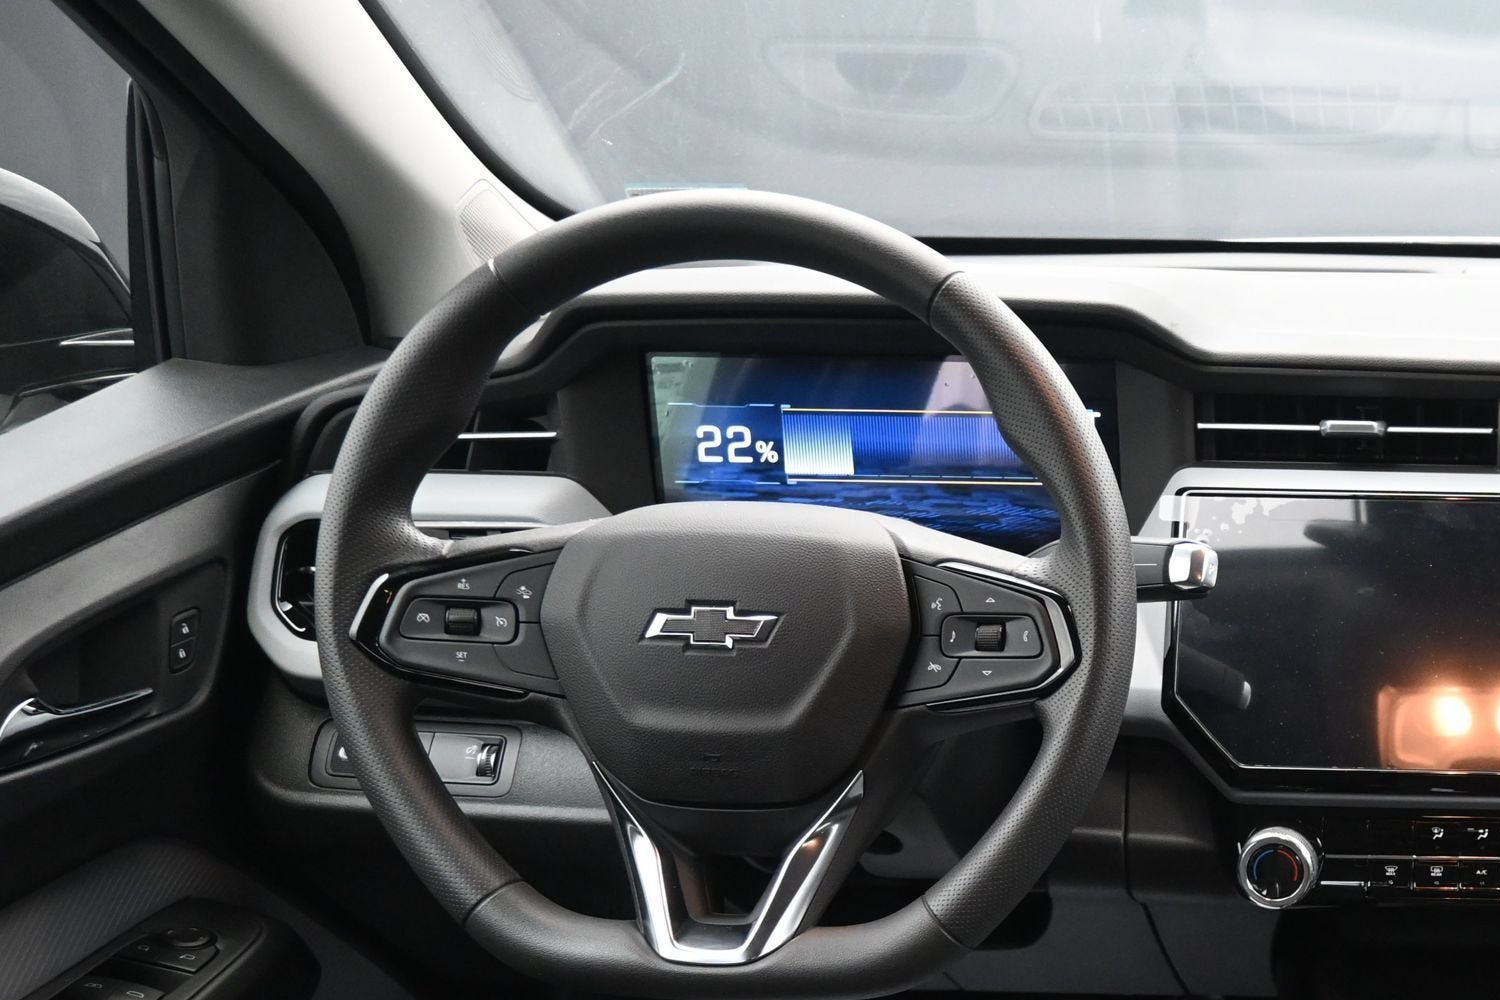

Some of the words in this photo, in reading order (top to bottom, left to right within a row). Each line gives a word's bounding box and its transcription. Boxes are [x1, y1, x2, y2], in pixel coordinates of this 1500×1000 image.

[695, 424, 779, 463] 22%
[457, 582, 471, 590] RES
[455, 651, 468, 659] SET
